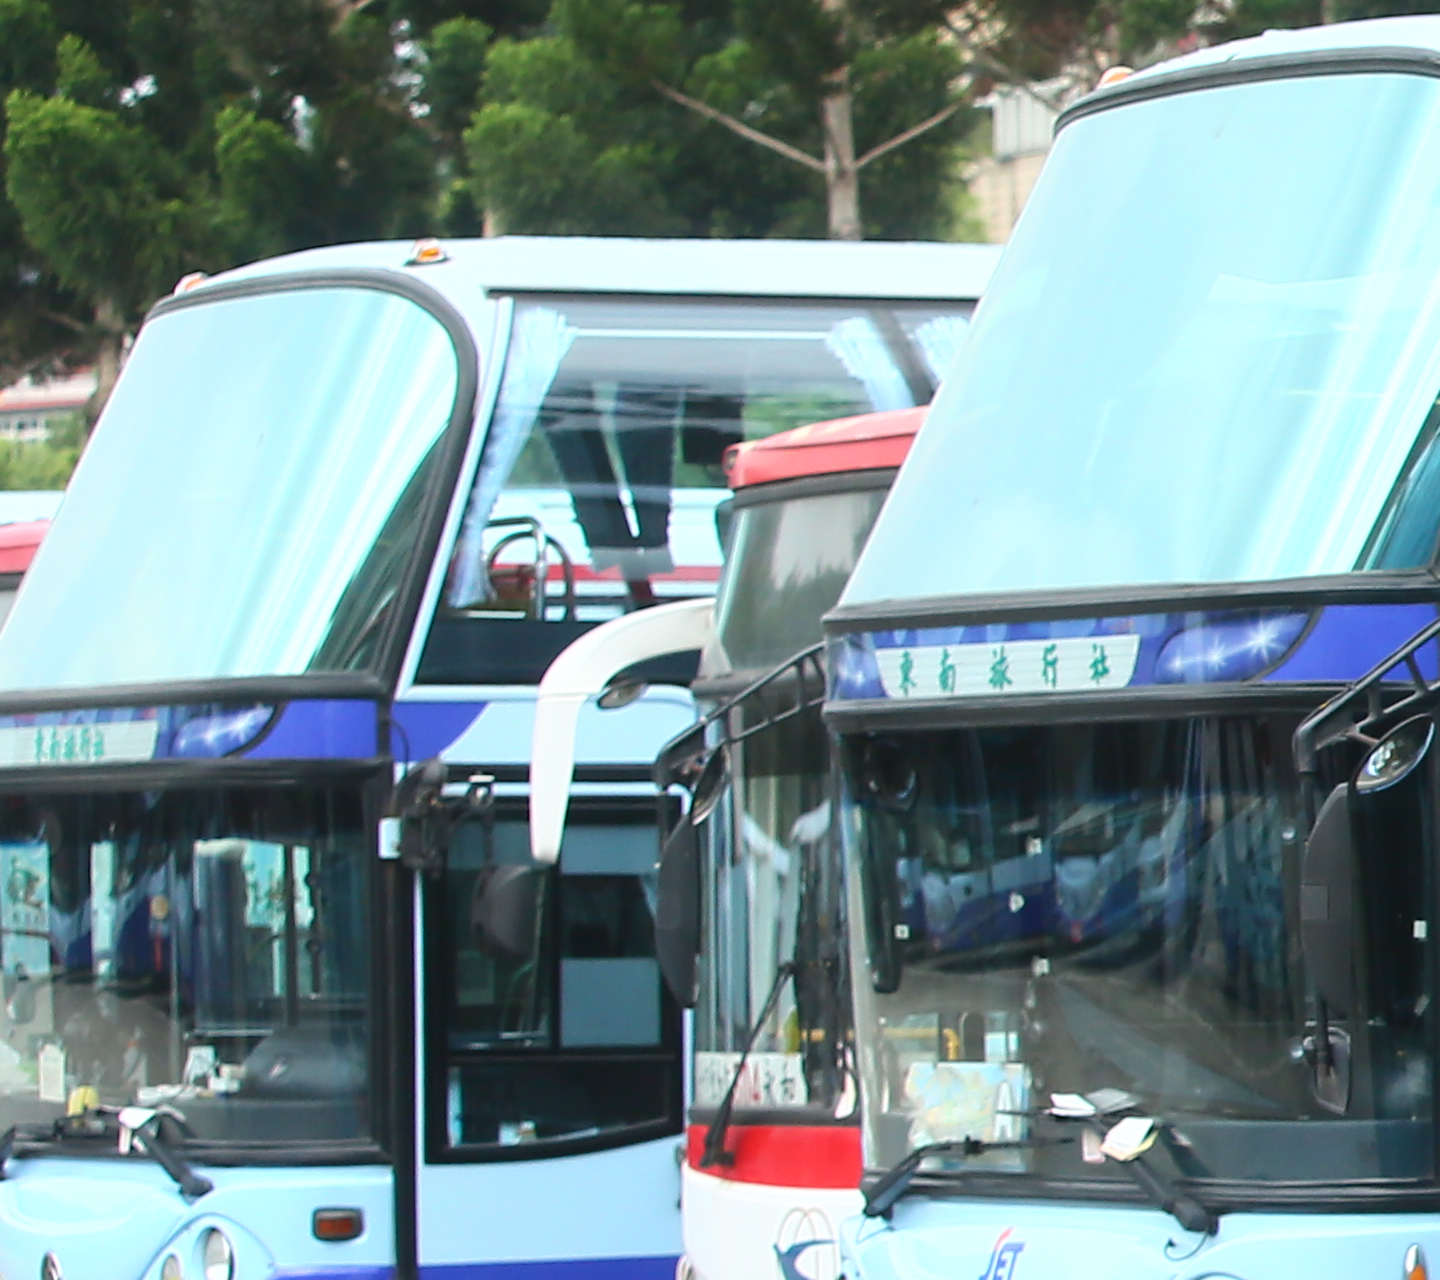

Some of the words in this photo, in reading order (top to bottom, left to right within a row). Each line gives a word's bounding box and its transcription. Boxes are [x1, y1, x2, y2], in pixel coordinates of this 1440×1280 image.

[899, 643, 1109, 697] 東南旅行社
